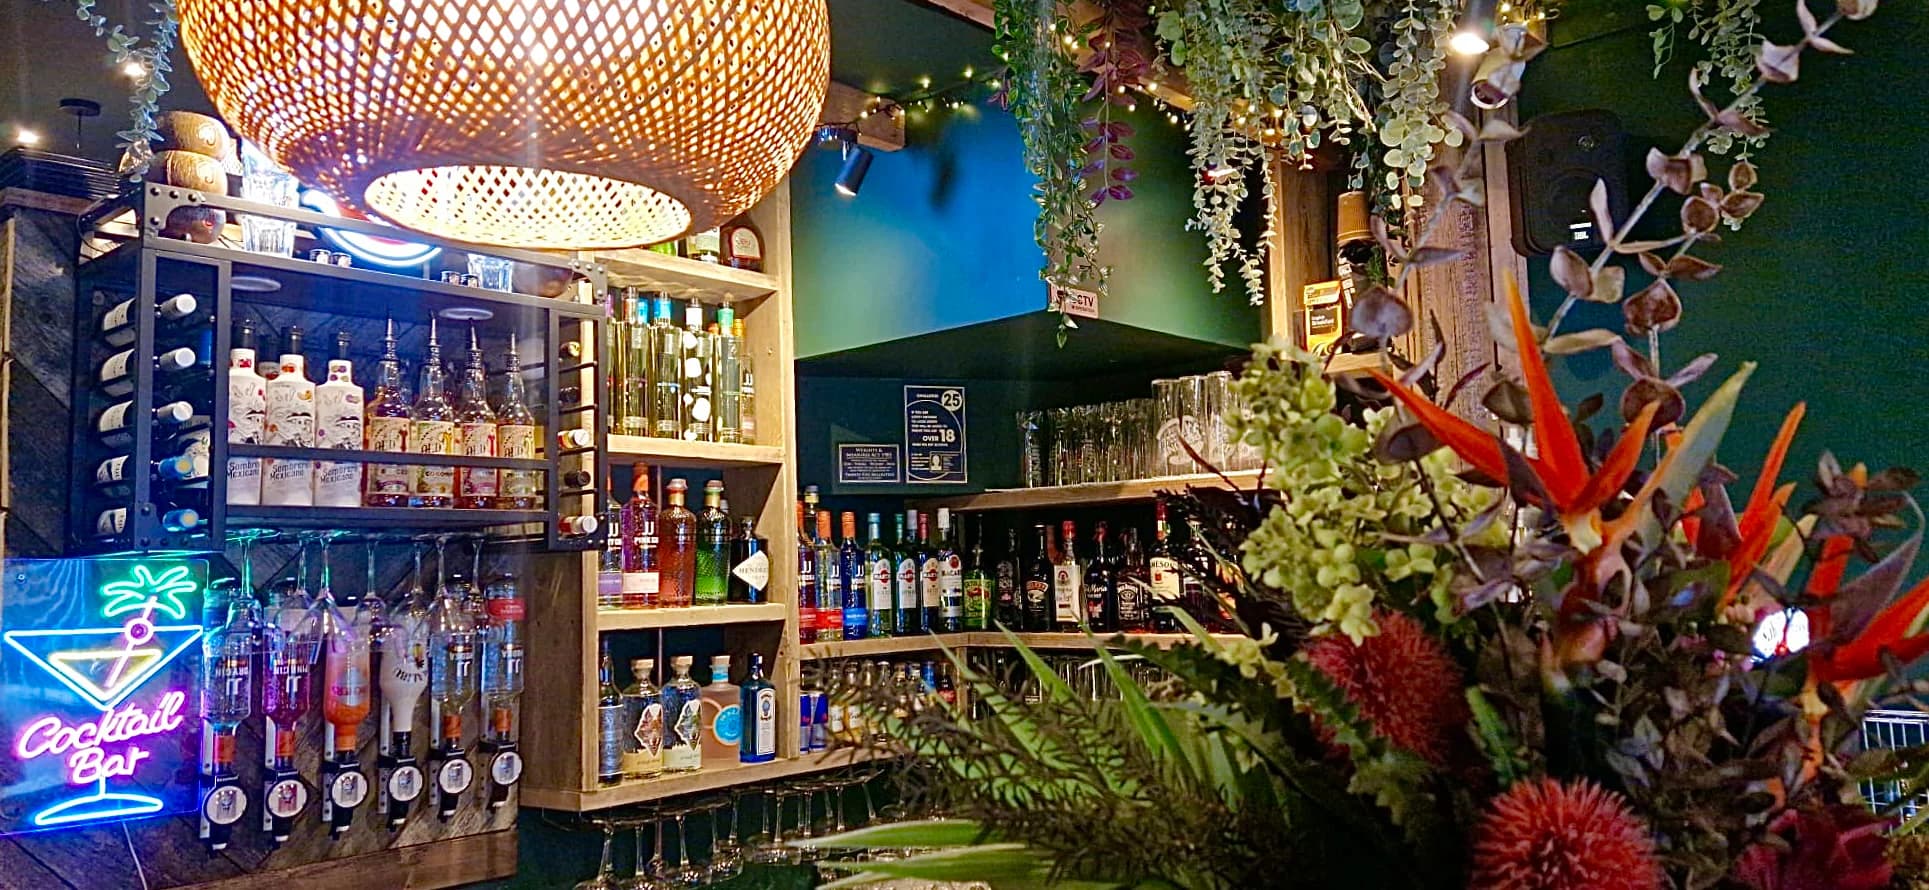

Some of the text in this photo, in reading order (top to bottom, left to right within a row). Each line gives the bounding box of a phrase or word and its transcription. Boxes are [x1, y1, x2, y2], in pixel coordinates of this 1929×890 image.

[944, 393, 960, 407] 25
[939, 429, 956, 443] 18
[644, 521, 655, 536] JJ
[801, 560, 812, 574] JJ
[831, 564, 840, 577] JJ
[855, 563, 865, 576] JJ
[18, 691, 184, 759] Cocktail
[69, 745, 149, 784] Bar
